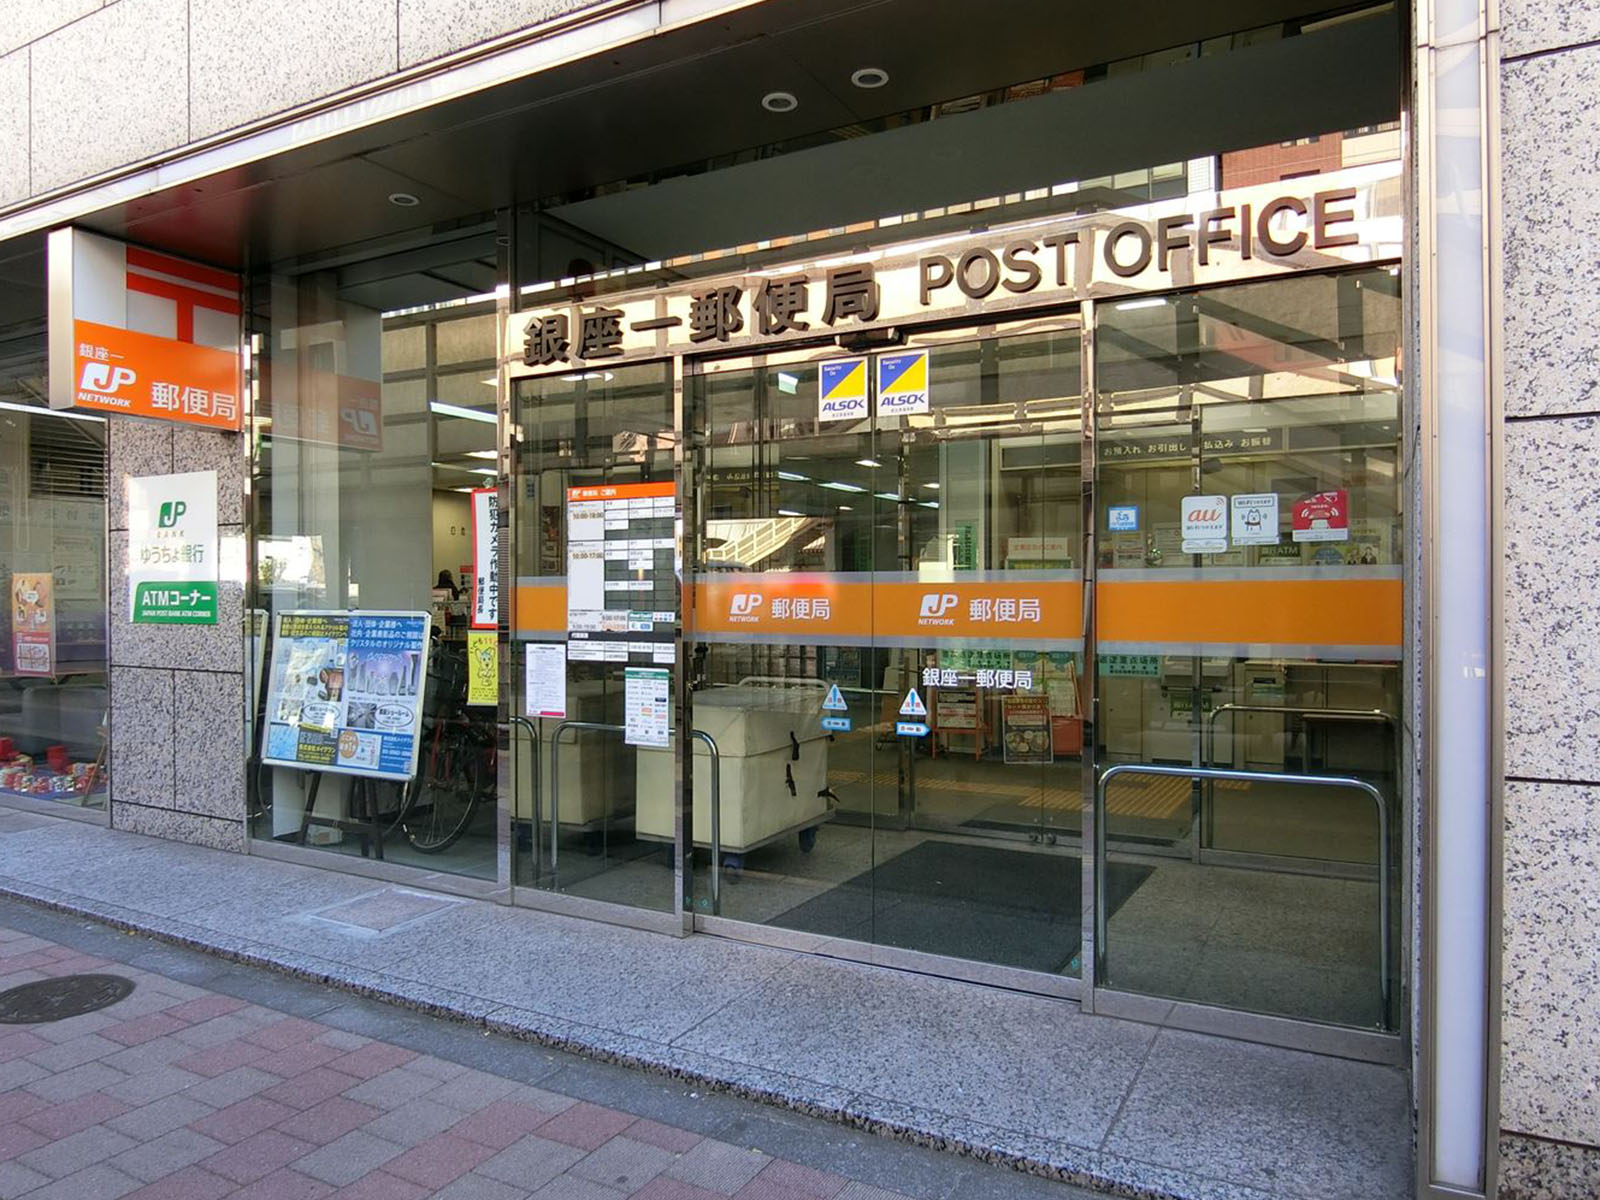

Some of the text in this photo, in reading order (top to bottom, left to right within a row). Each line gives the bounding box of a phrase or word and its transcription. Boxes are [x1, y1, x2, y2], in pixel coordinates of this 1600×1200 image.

[919, 187, 1359, 306] POST OFFICE
[523, 262, 881, 367] 銀座一郵便局
[79, 343, 125, 362] 銀座一
[77, 392, 131, 408] NETWORK
[151, 382, 236, 421] 郵便局
[822, 399, 865, 412] ALSOK
[881, 393, 925, 407] ALSOK
[1188, 509, 1222, 522] au
[141, 544, 204, 564] ゆうちょ銀行
[142, 589, 211, 606] ATMコーナー
[771, 598, 830, 620] 郵便局
[969, 598, 1040, 622] 郵便局
[918, 618, 955, 626] NETWORK
[922, 668, 1032, 690] 銀座一郵便局
